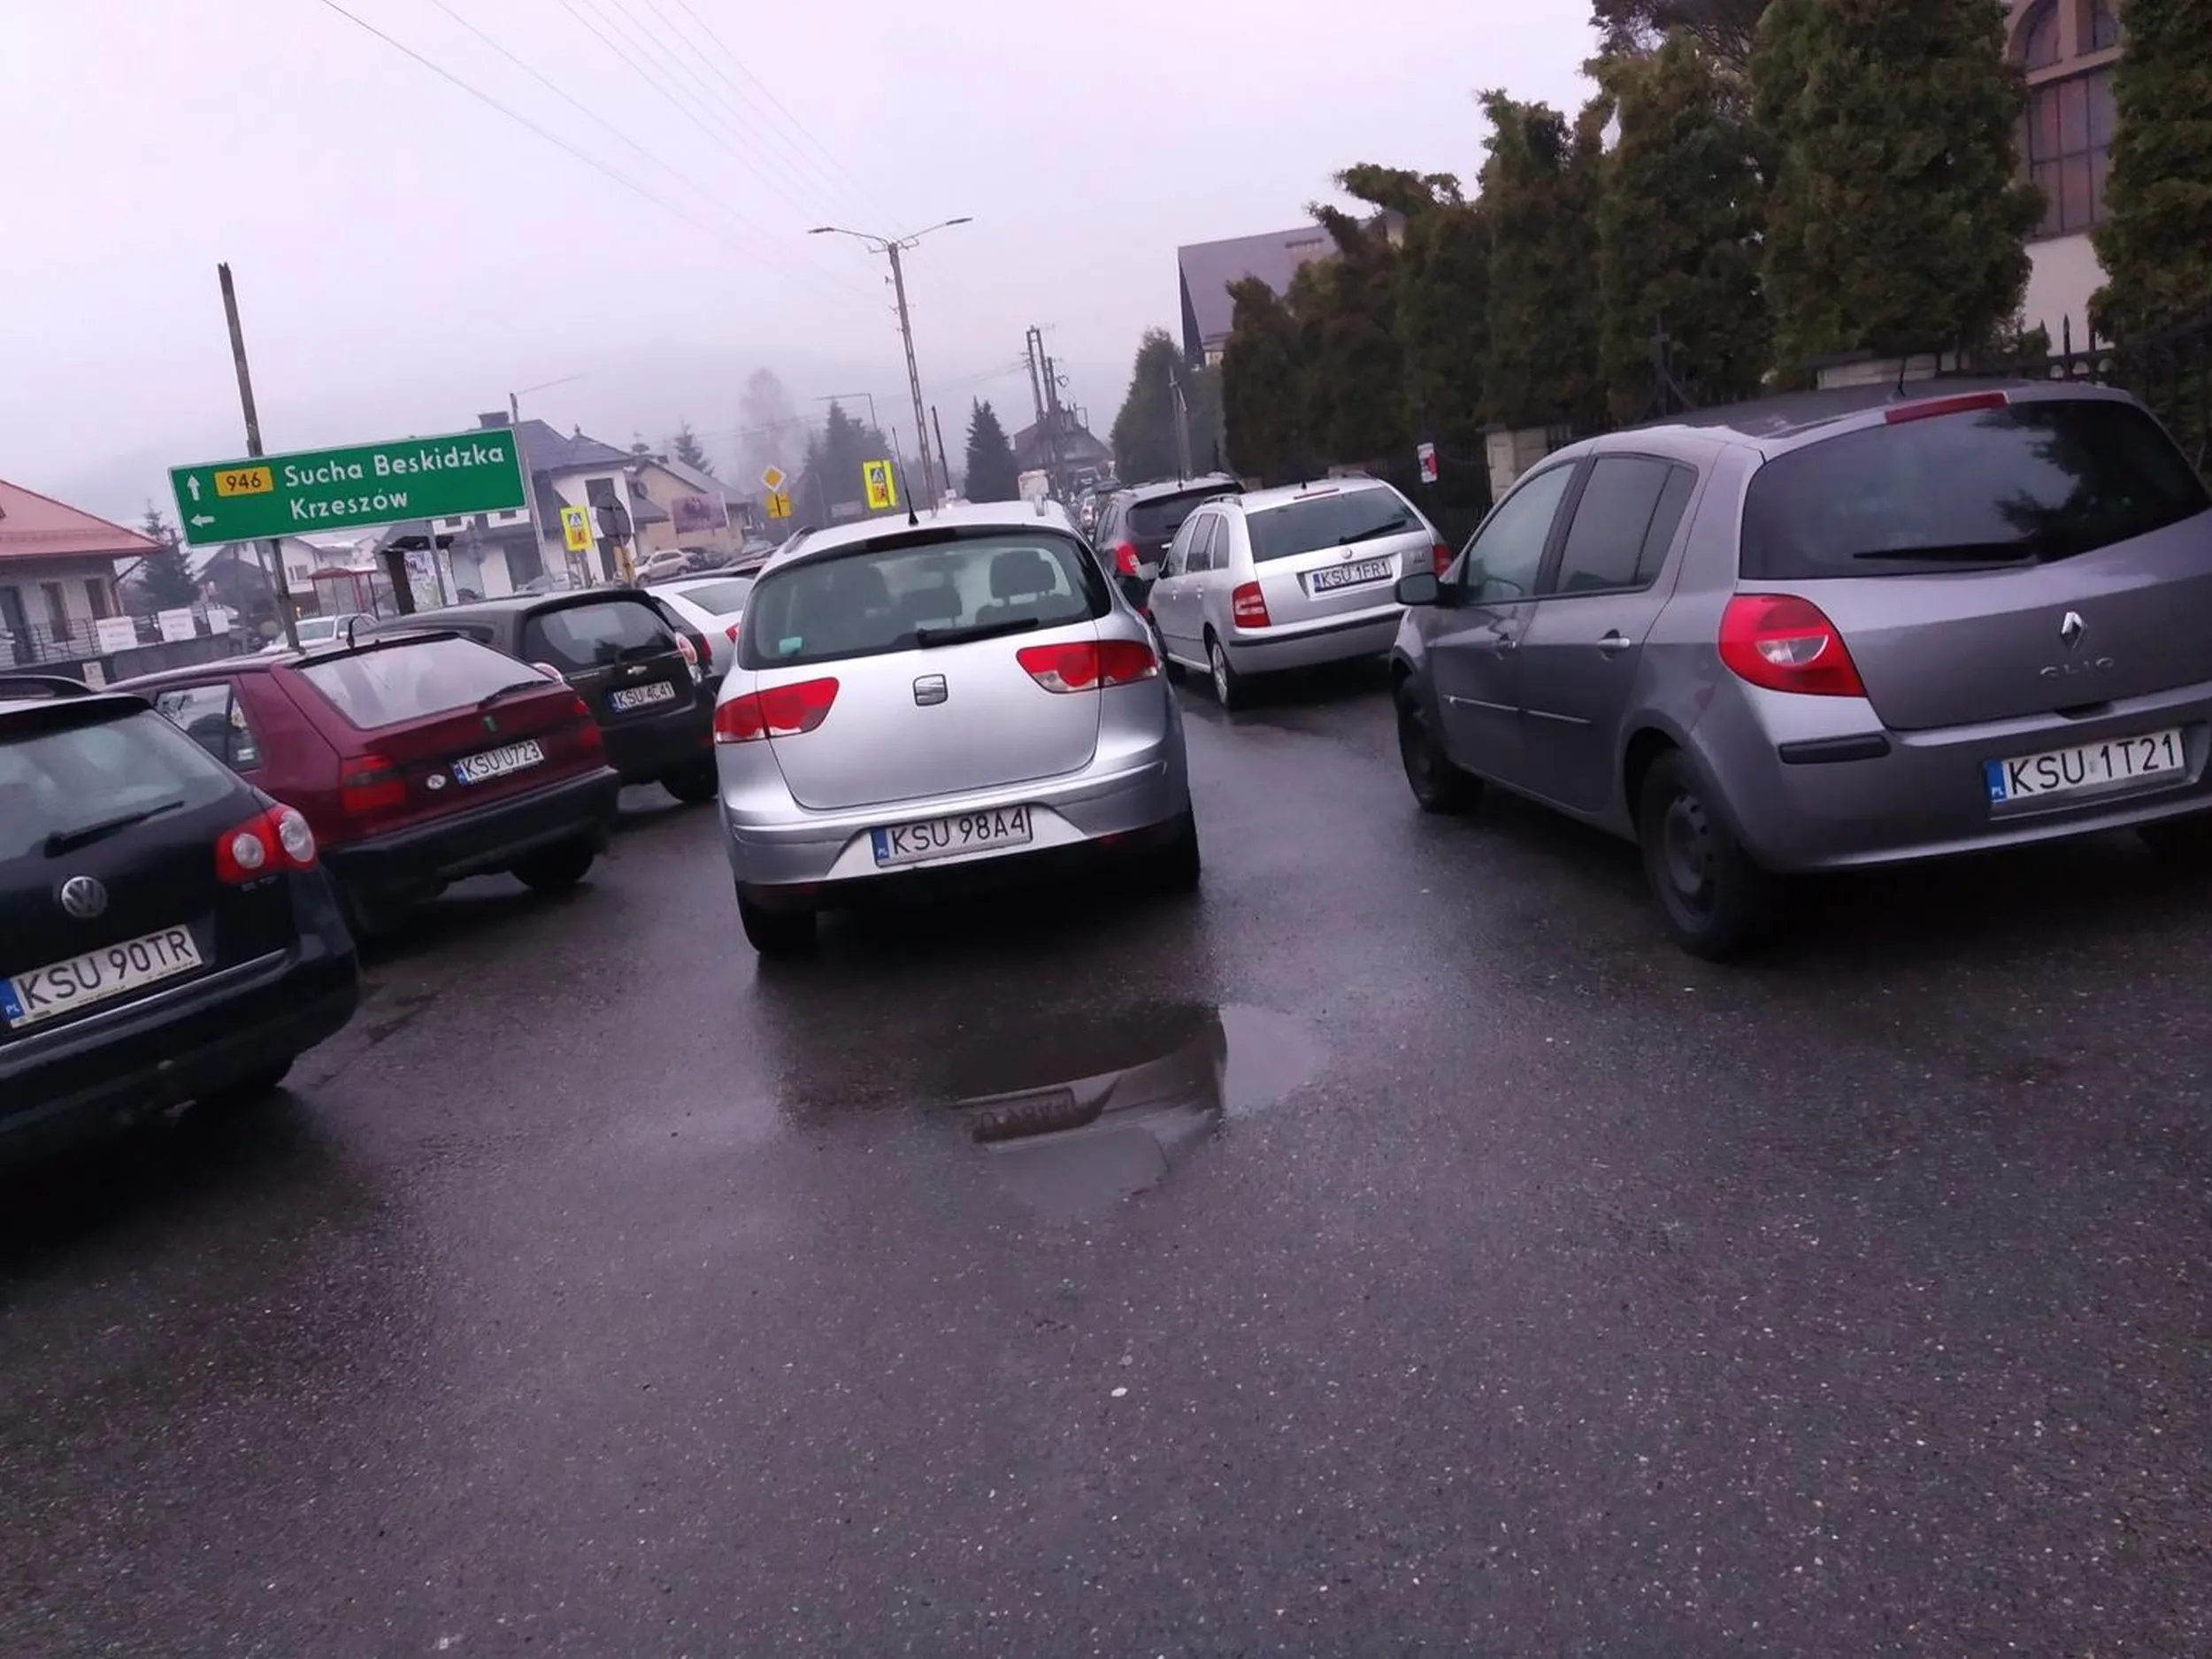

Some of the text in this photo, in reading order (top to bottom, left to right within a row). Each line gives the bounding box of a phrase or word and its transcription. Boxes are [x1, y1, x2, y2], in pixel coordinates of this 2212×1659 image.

[226, 471, 262, 492] 946
[284, 444, 504, 488] Sucha Beskidzka
[290, 488, 408, 520] Krzeszów
[1320, 560, 1388, 587] KSU 1FR1
[615, 689, 644, 709] KSU
[462, 741, 540, 779] KSU U723
[2008, 733, 2176, 795] KSU 1T21
[891, 807, 1025, 855] KSU 98A4
[17, 930, 193, 1010] KSU 90TR
